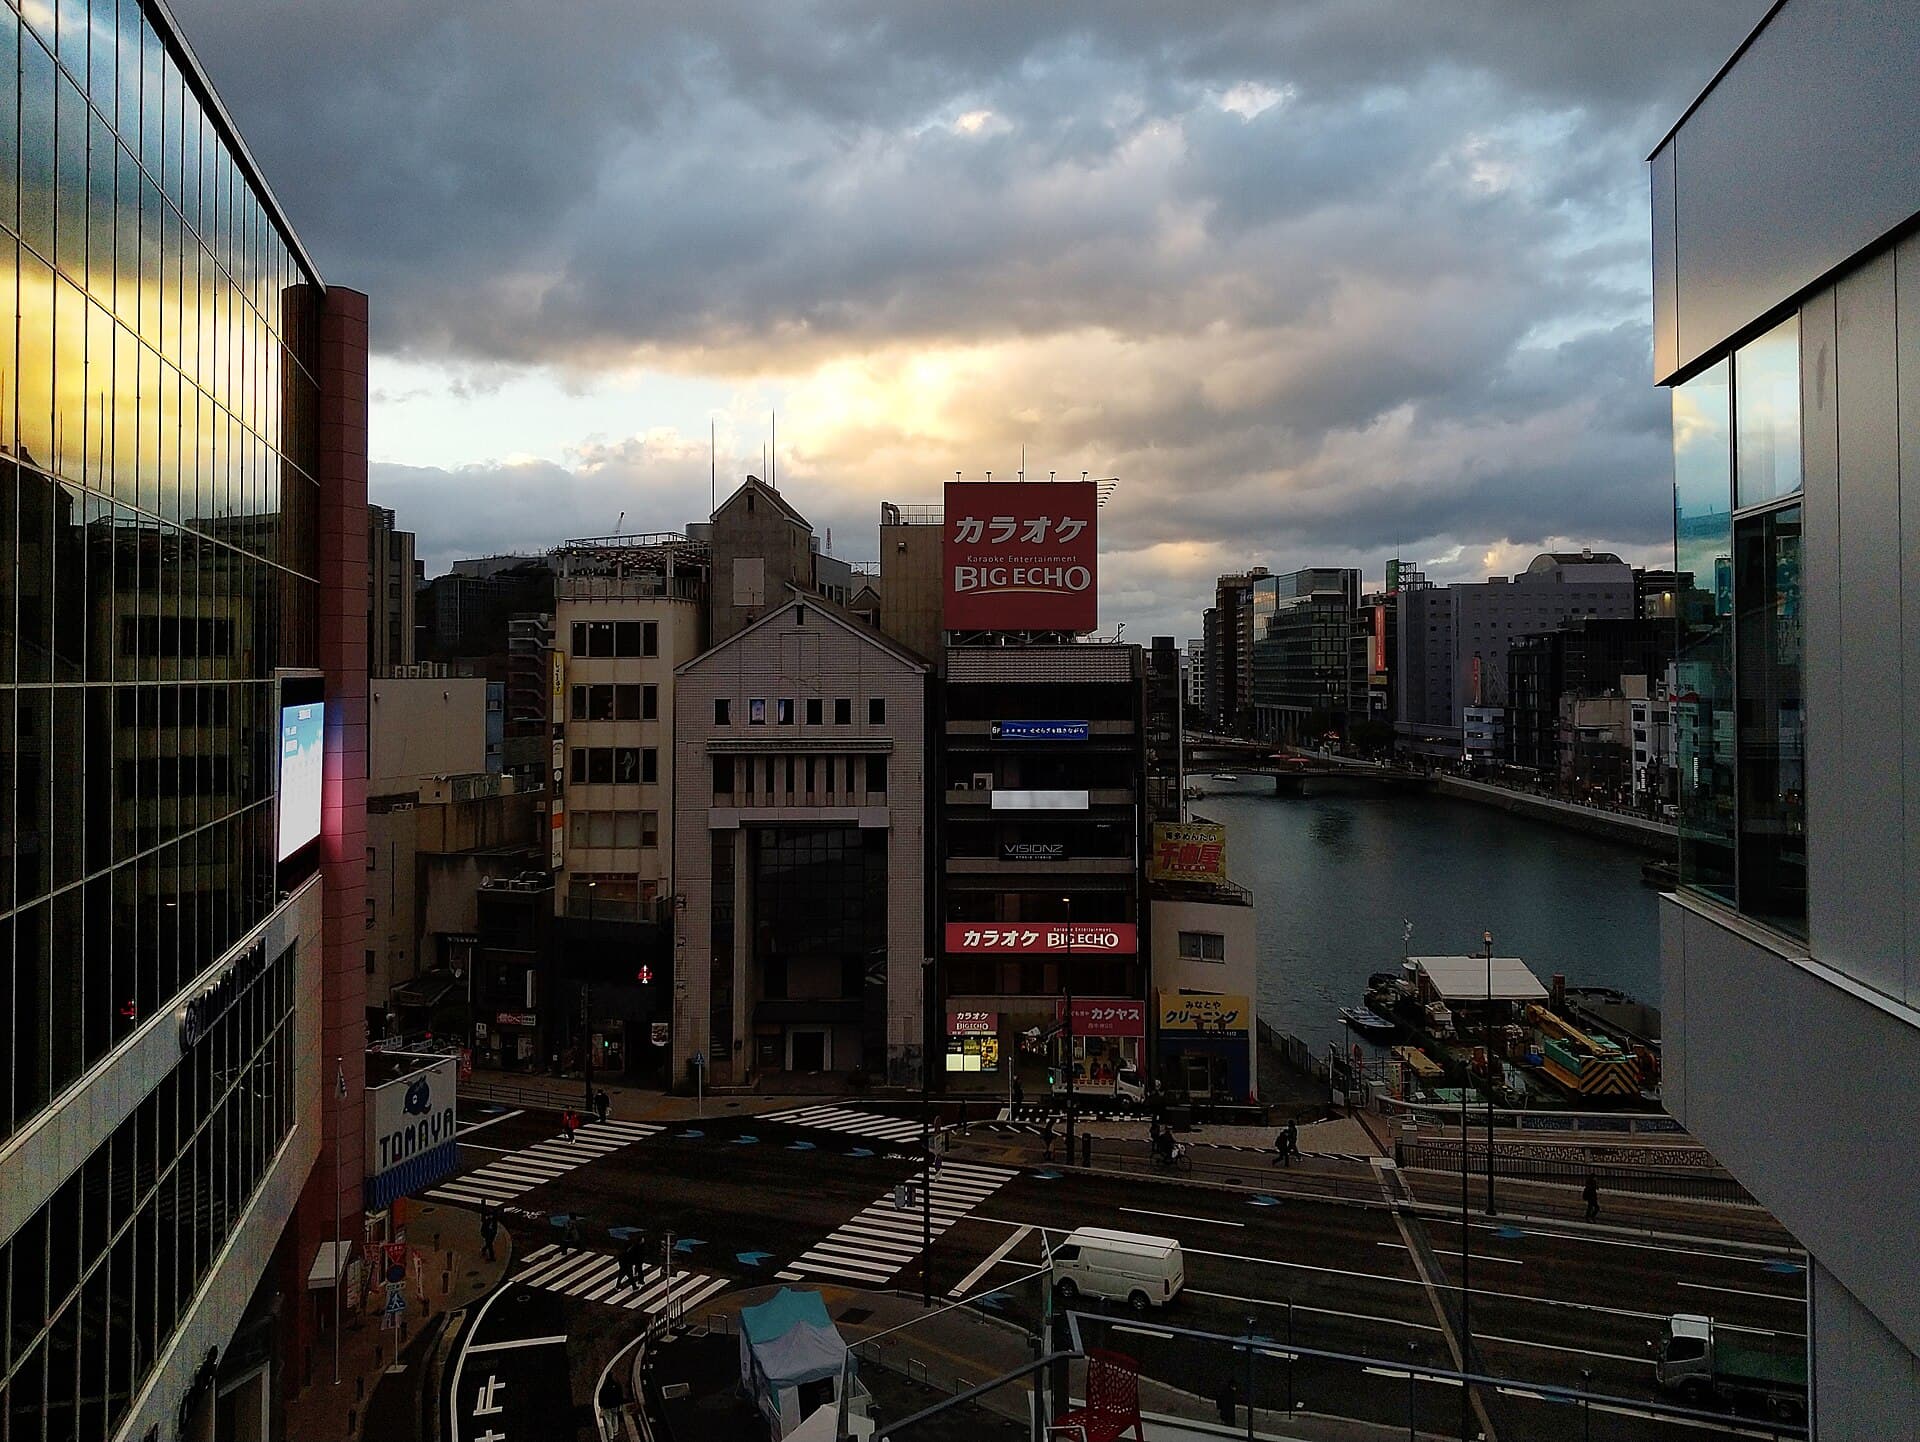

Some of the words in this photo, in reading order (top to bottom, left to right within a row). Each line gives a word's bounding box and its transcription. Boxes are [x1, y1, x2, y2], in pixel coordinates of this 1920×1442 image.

[953, 516, 1087, 544] カラオケ
[967, 555, 1004, 563] Karaoke
[1008, 555, 1076, 563] Entertainment
[955, 566, 1007, 592] BIG
[1013, 565, 1092, 591] ECHO
[963, 930, 1039, 947] カラオケ
[1047, 933, 1075, 948] BIG
[1077, 933, 1119, 948] ECHO
[1185, 1001, 1221, 1009] みなとや
[956, 1012, 989, 1021] カラオケ
[1091, 1007, 1140, 1021] カクヤス
[1166, 1009, 1240, 1024] クリーニング
